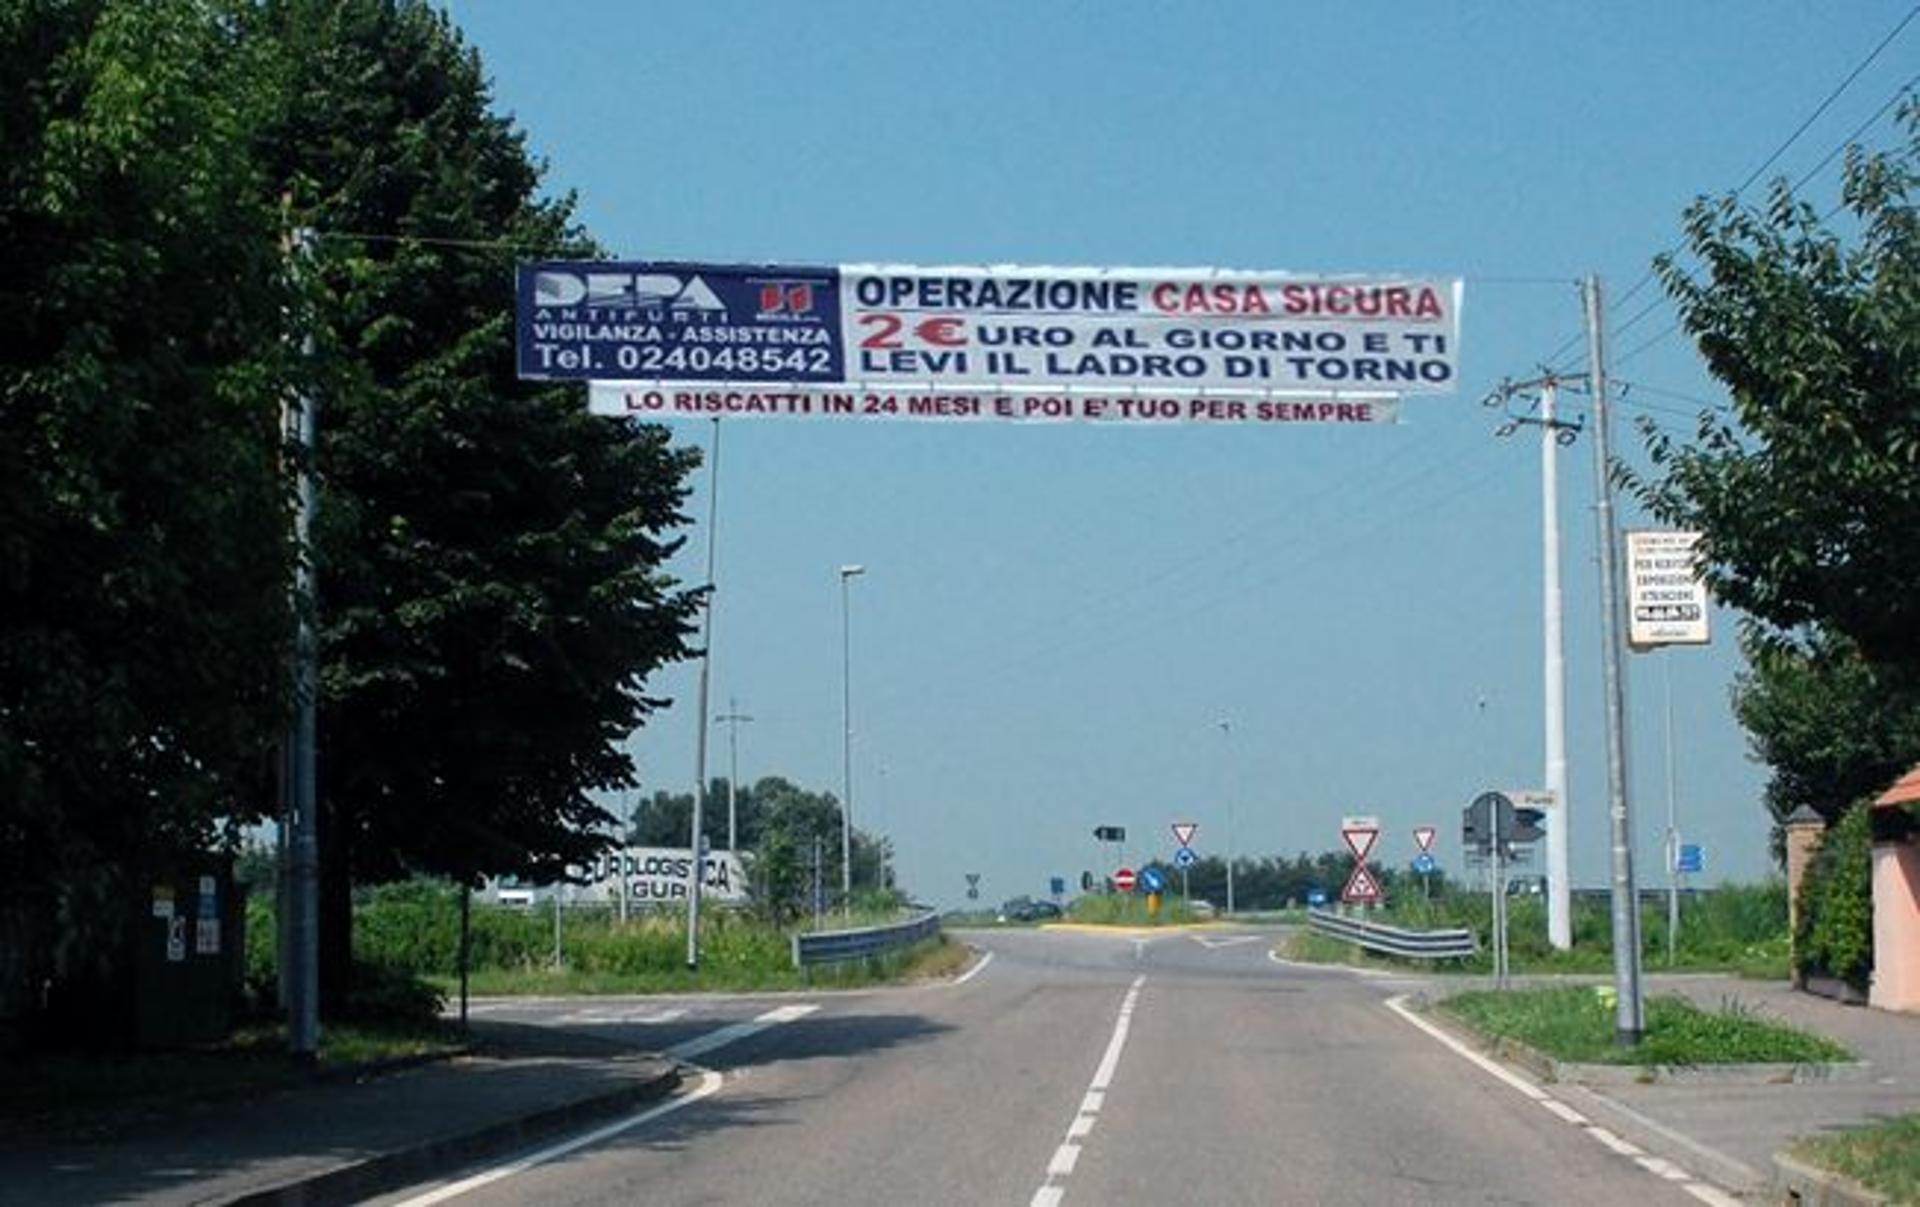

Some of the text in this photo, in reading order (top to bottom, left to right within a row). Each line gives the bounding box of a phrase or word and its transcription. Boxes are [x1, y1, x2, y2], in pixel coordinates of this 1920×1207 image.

[535, 273, 727, 309] DEPA
[857, 277, 1442, 317] OPERAZIONE CASA SICURA
[534, 307, 729, 323] ANTIFURTI
[533, 324, 662, 342] VIGILANZA
[682, 327, 830, 345] ASSISTENZA
[858, 314, 904, 348] 2
[1091, 327, 1149, 348] AL
[1165, 329, 1346, 352] GIORNO
[1363, 332, 1390, 353] E
[1403, 334, 1446, 354] TI
[534, 344, 831, 373] Tel. 024048542
[861, 350, 1451, 382] LEVI IL LADRO DI TORNO
[625, 391, 664, 411] LO
[674, 392, 811, 414] RISCATTI
[823, 394, 854, 413] IN
[864, 394, 898, 414] 24
[909, 395, 979, 415] MESI
[995, 397, 1013, 417] E
[1024, 398, 1072, 417] POI
[1117, 399, 1180, 418] TUO
[1189, 400, 1246, 420] PER
[1257, 402, 1372, 422] SEMPRE
